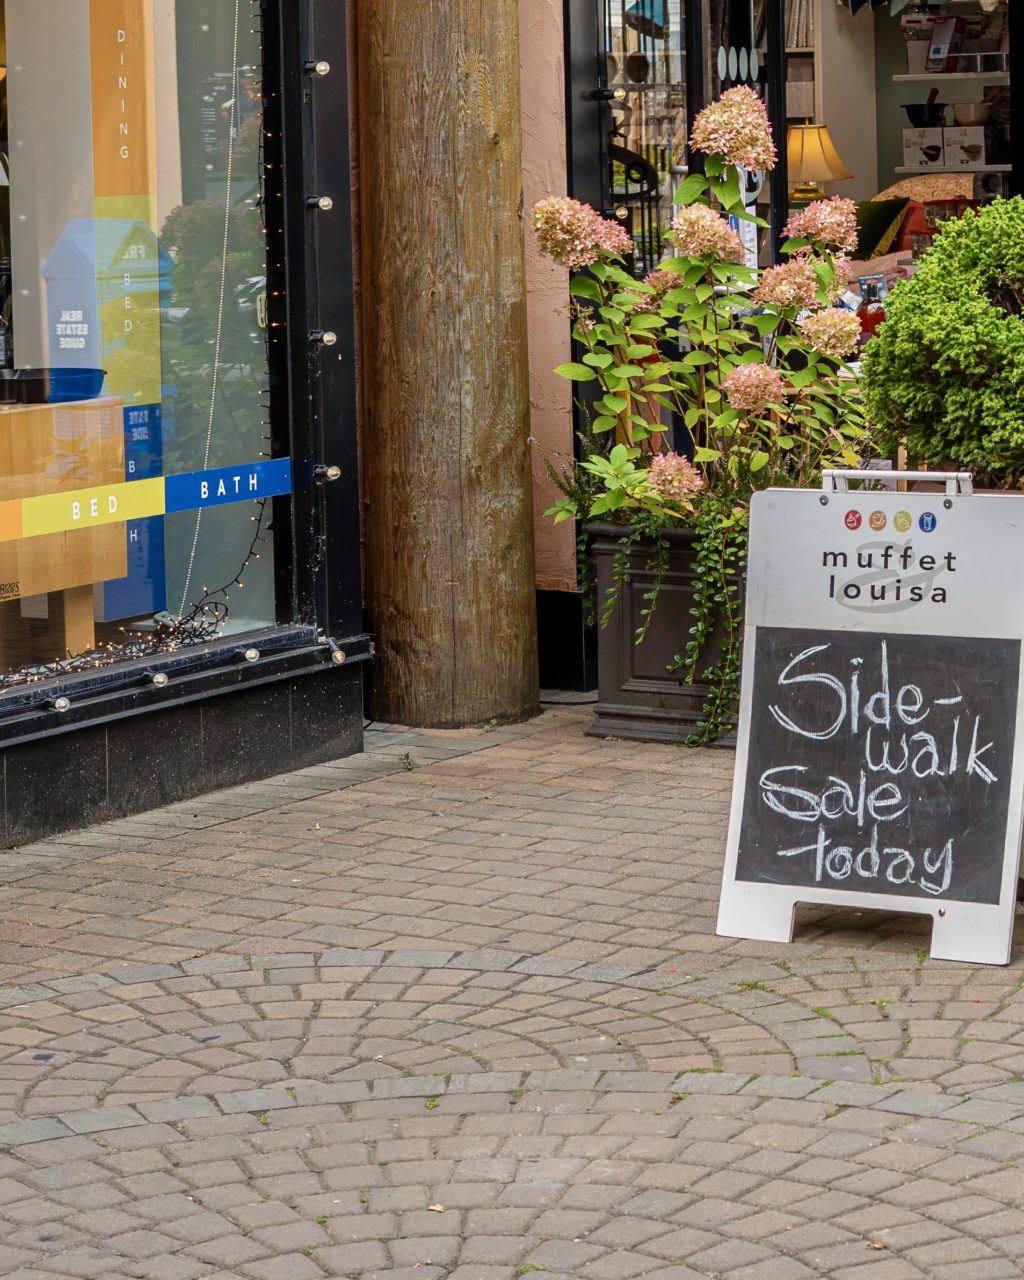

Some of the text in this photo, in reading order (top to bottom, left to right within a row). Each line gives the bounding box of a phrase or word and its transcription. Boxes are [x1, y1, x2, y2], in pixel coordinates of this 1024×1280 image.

[117, 29, 129, 159] DINING
[124, 273, 133, 332] BED
[72, 495, 118, 520] BED
[200, 474, 258, 499] BATH
[822, 545, 957, 572] muffet
[829, 574, 947, 603] louisa
[768, 639, 965, 740] Side-
[865, 714, 999, 784] walk
[759, 765, 908, 827] Sale
[777, 822, 954, 895] today
